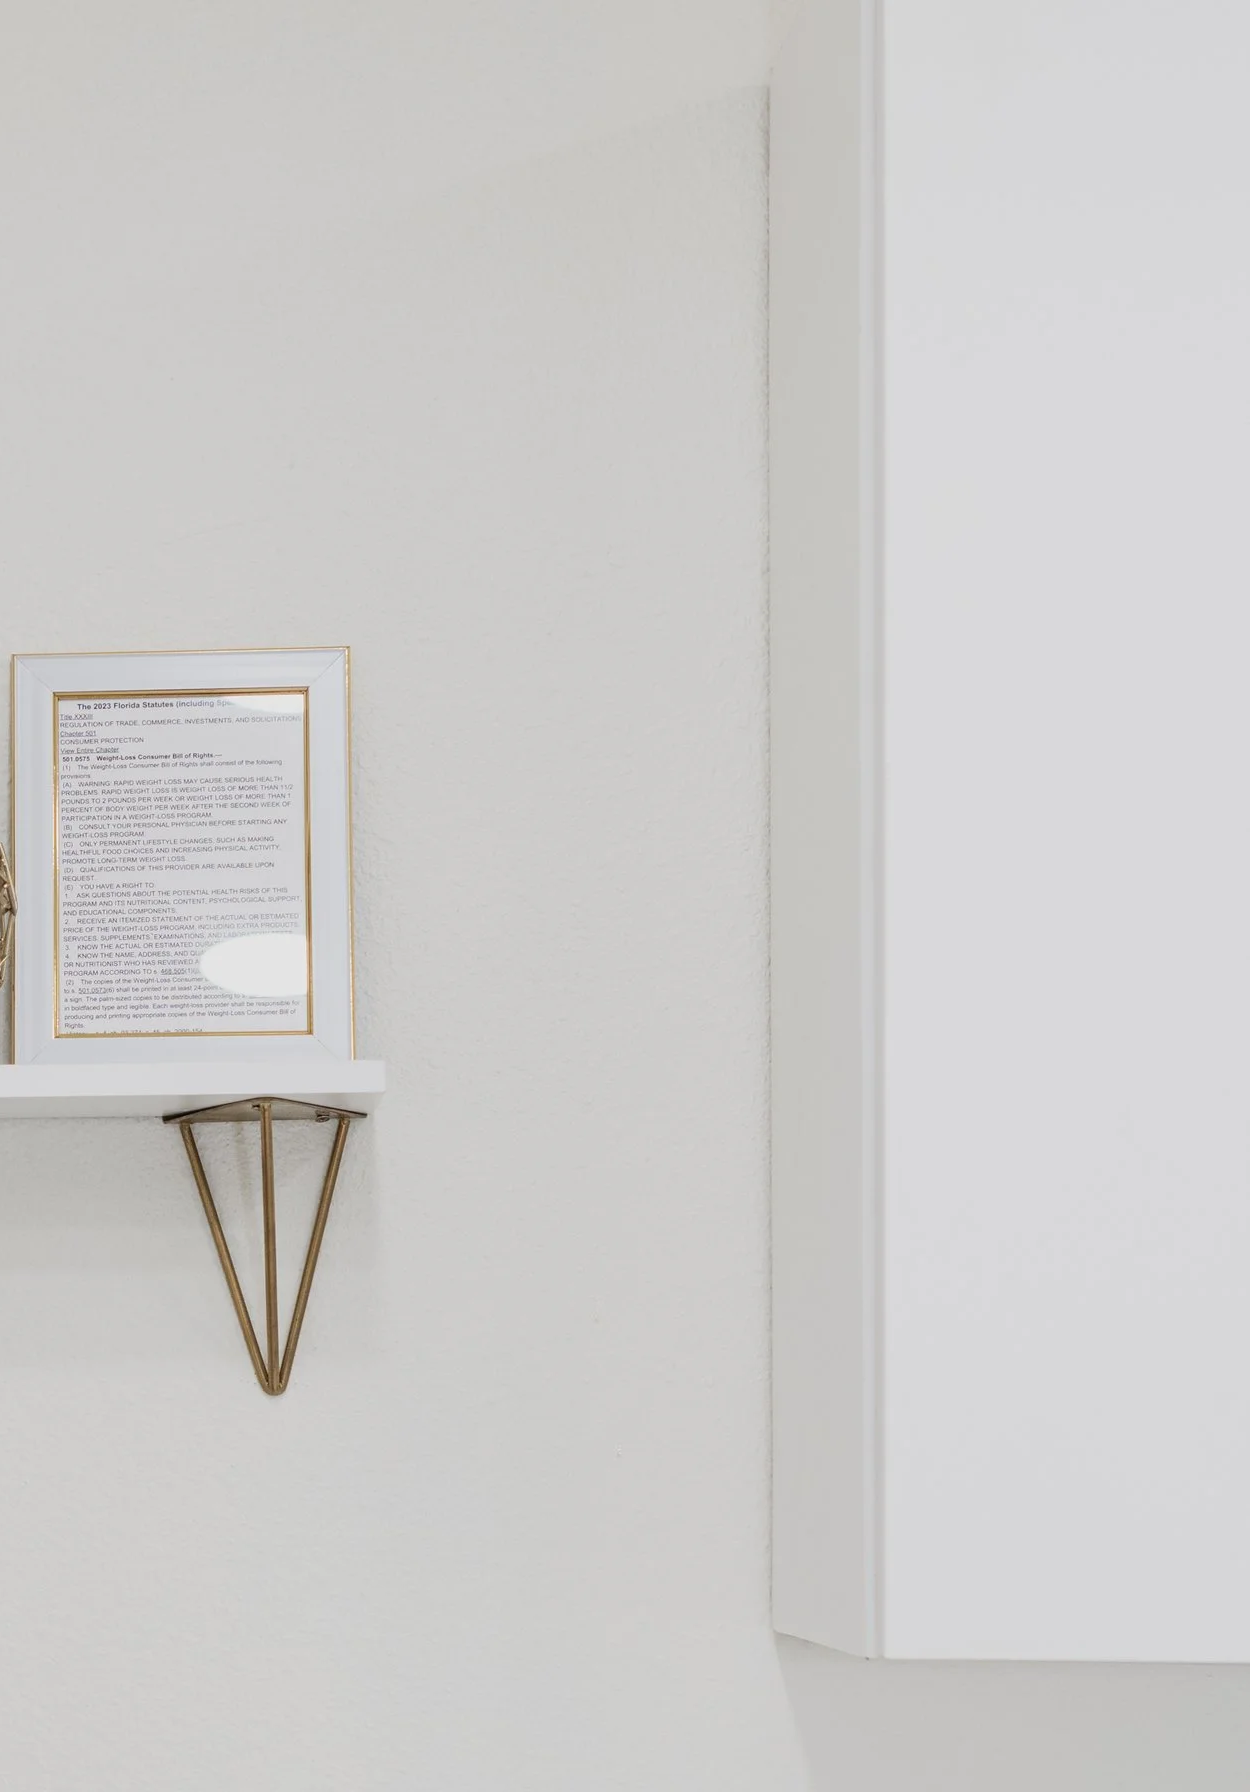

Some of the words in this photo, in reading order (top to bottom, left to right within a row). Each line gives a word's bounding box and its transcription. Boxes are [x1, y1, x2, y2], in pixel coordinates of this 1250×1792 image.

[142, 700, 174, 708] Statutes
[176, 699, 214, 709] (including
[60, 731, 84, 739] Chapter
[95, 747, 119, 756] Chapter
[96, 754, 136, 763] Weight-Loss
[62, 764, 71, 772] (1)
[90, 763, 127, 771] Weight-Loss
[179, 761, 198, 769] Rights
[256, 759, 283, 767] following
[63, 781, 72, 789] (A)
